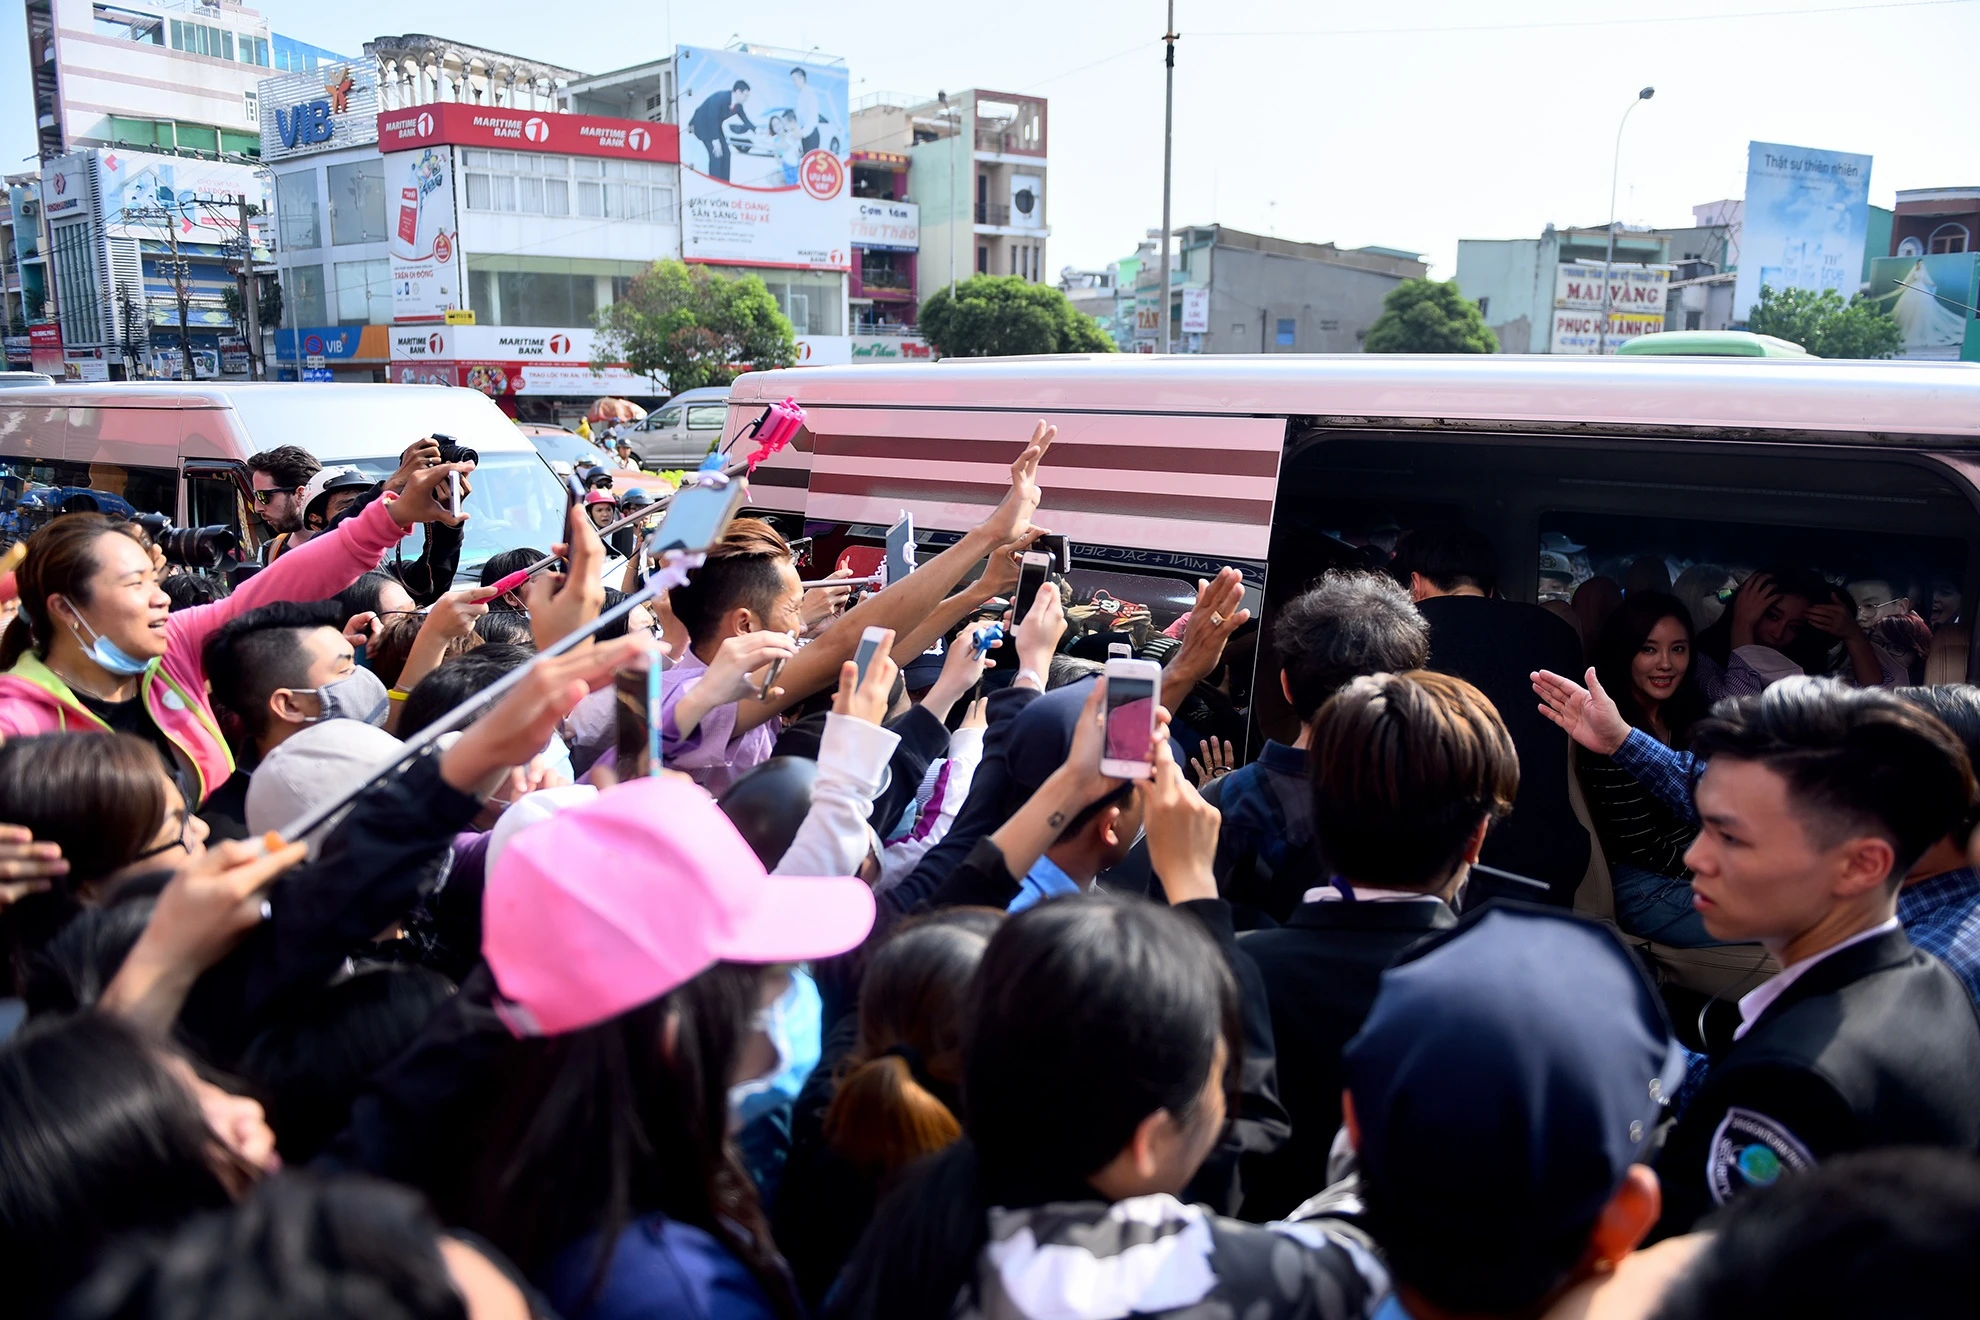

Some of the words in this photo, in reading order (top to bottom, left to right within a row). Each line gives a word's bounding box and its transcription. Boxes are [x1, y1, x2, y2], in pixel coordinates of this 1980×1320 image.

[275, 100, 334, 148] VIB
[386, 118, 417, 132] MARITIME
[473, 116, 522, 129] MARITIME
[398, 127, 416, 139] BANK
[494, 127, 521, 138] BANK
[580, 126, 626, 138] MARITIME
[599, 137, 625, 148] BANK
[1765, 154, 1788, 170] Thật
[1804, 159, 1829, 173] thiên
[1832, 162, 1859, 177] nhiên
[1567, 282, 1602, 300] MAI
[1610, 281, 1658, 303] VÀNG
[1557, 318, 1591, 336] PHỤC
[326, 340, 343, 353] VIB
[397, 337, 426, 345] MARITIME
[499, 338, 545, 346] MARITIME
[409, 346, 426, 354] BANK
[518, 347, 543, 355] BANK
